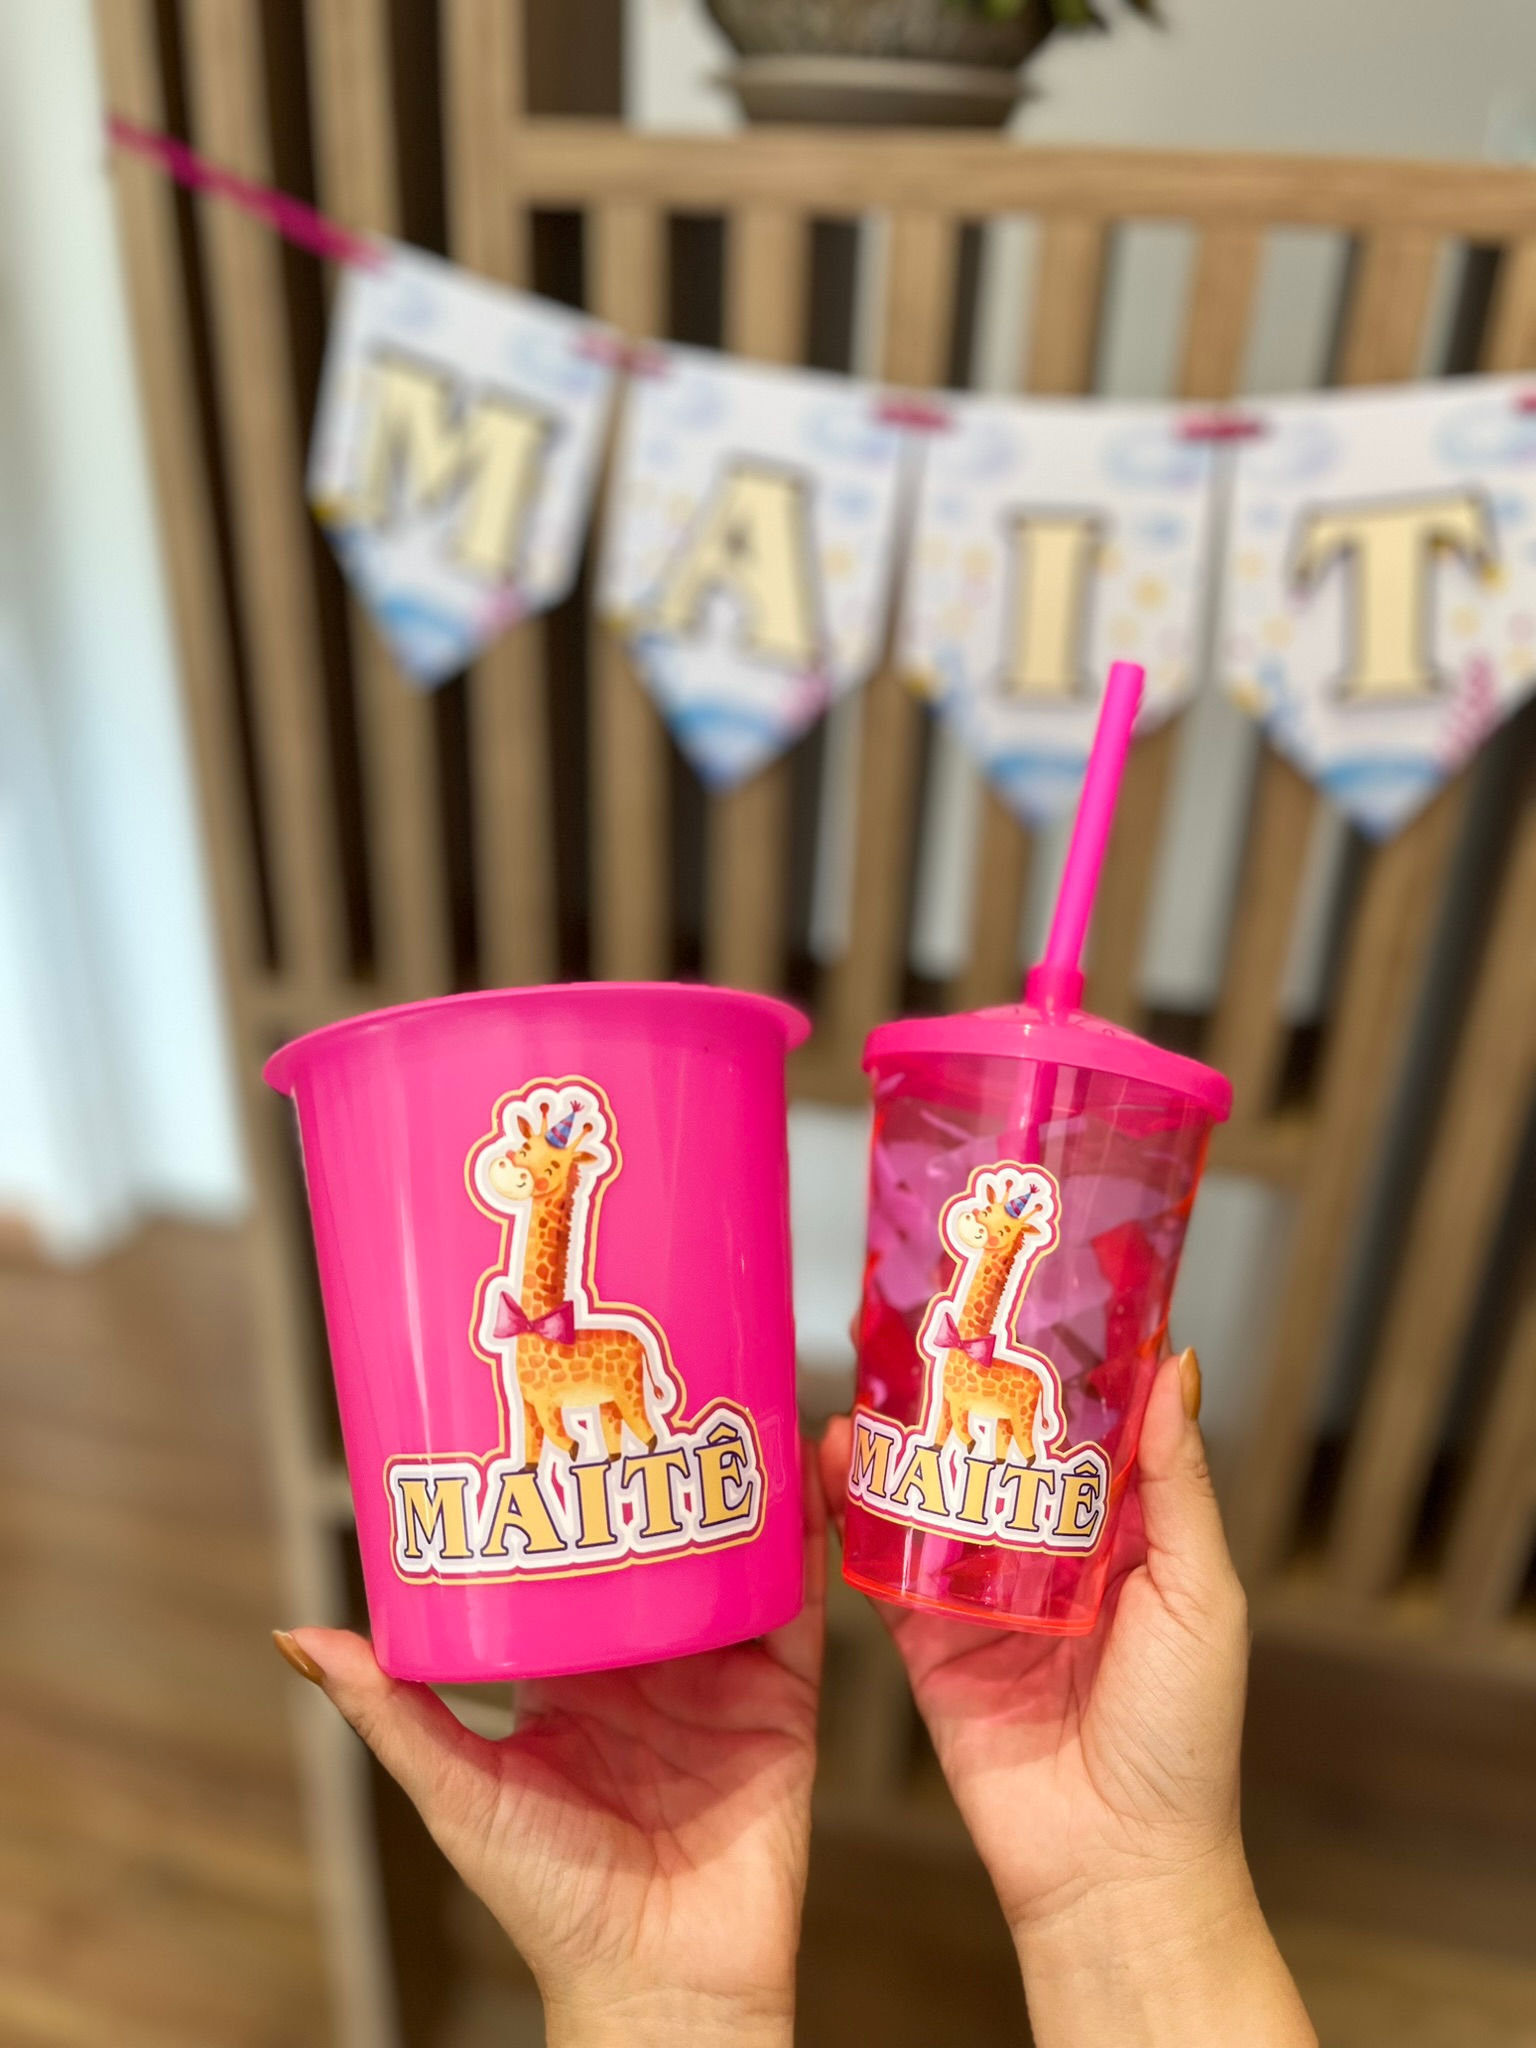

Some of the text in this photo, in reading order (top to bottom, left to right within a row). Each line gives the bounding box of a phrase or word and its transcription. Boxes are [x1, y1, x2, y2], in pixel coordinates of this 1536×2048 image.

[350, 342, 1500, 706] MAIT
[398, 1421, 754, 1559] MAITÊ
[852, 1424, 1101, 1538] MAITÊ
